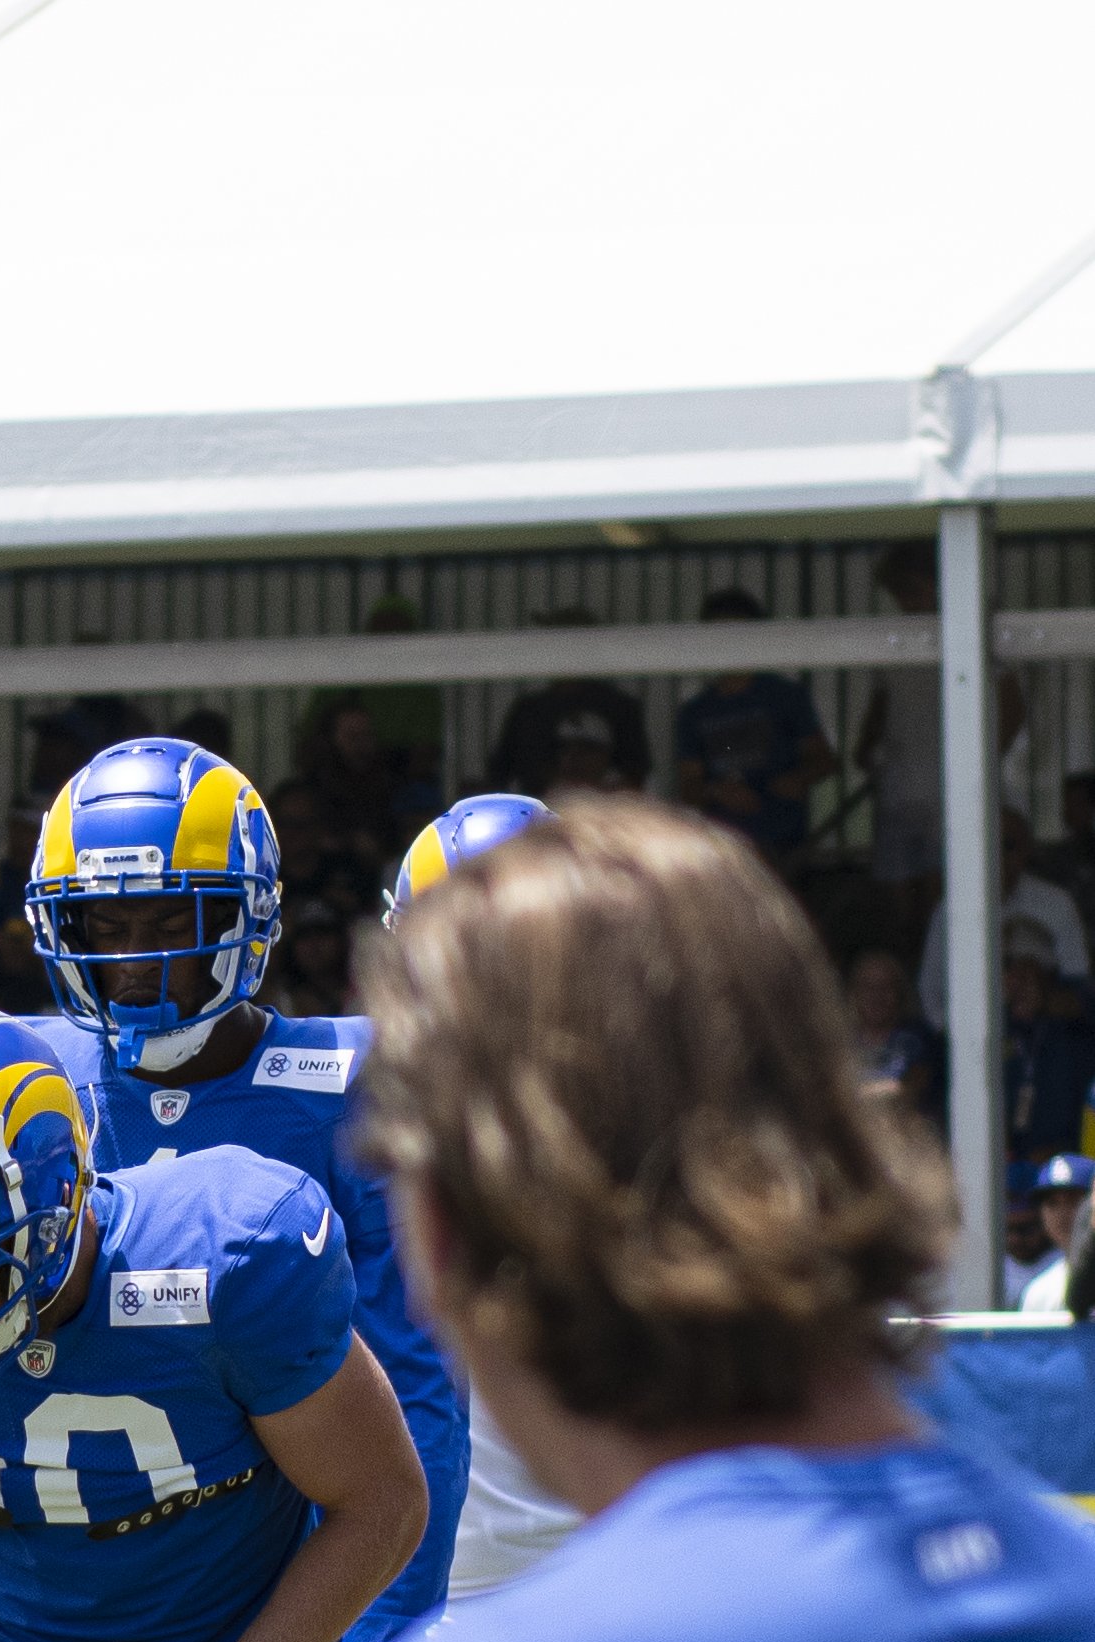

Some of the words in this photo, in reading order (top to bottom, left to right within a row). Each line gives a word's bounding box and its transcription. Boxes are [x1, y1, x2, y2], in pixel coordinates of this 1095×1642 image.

[103, 855, 139, 863] RAMS
[298, 1060, 344, 1072] UNIFY
[153, 1288, 201, 1302] UNIFY
